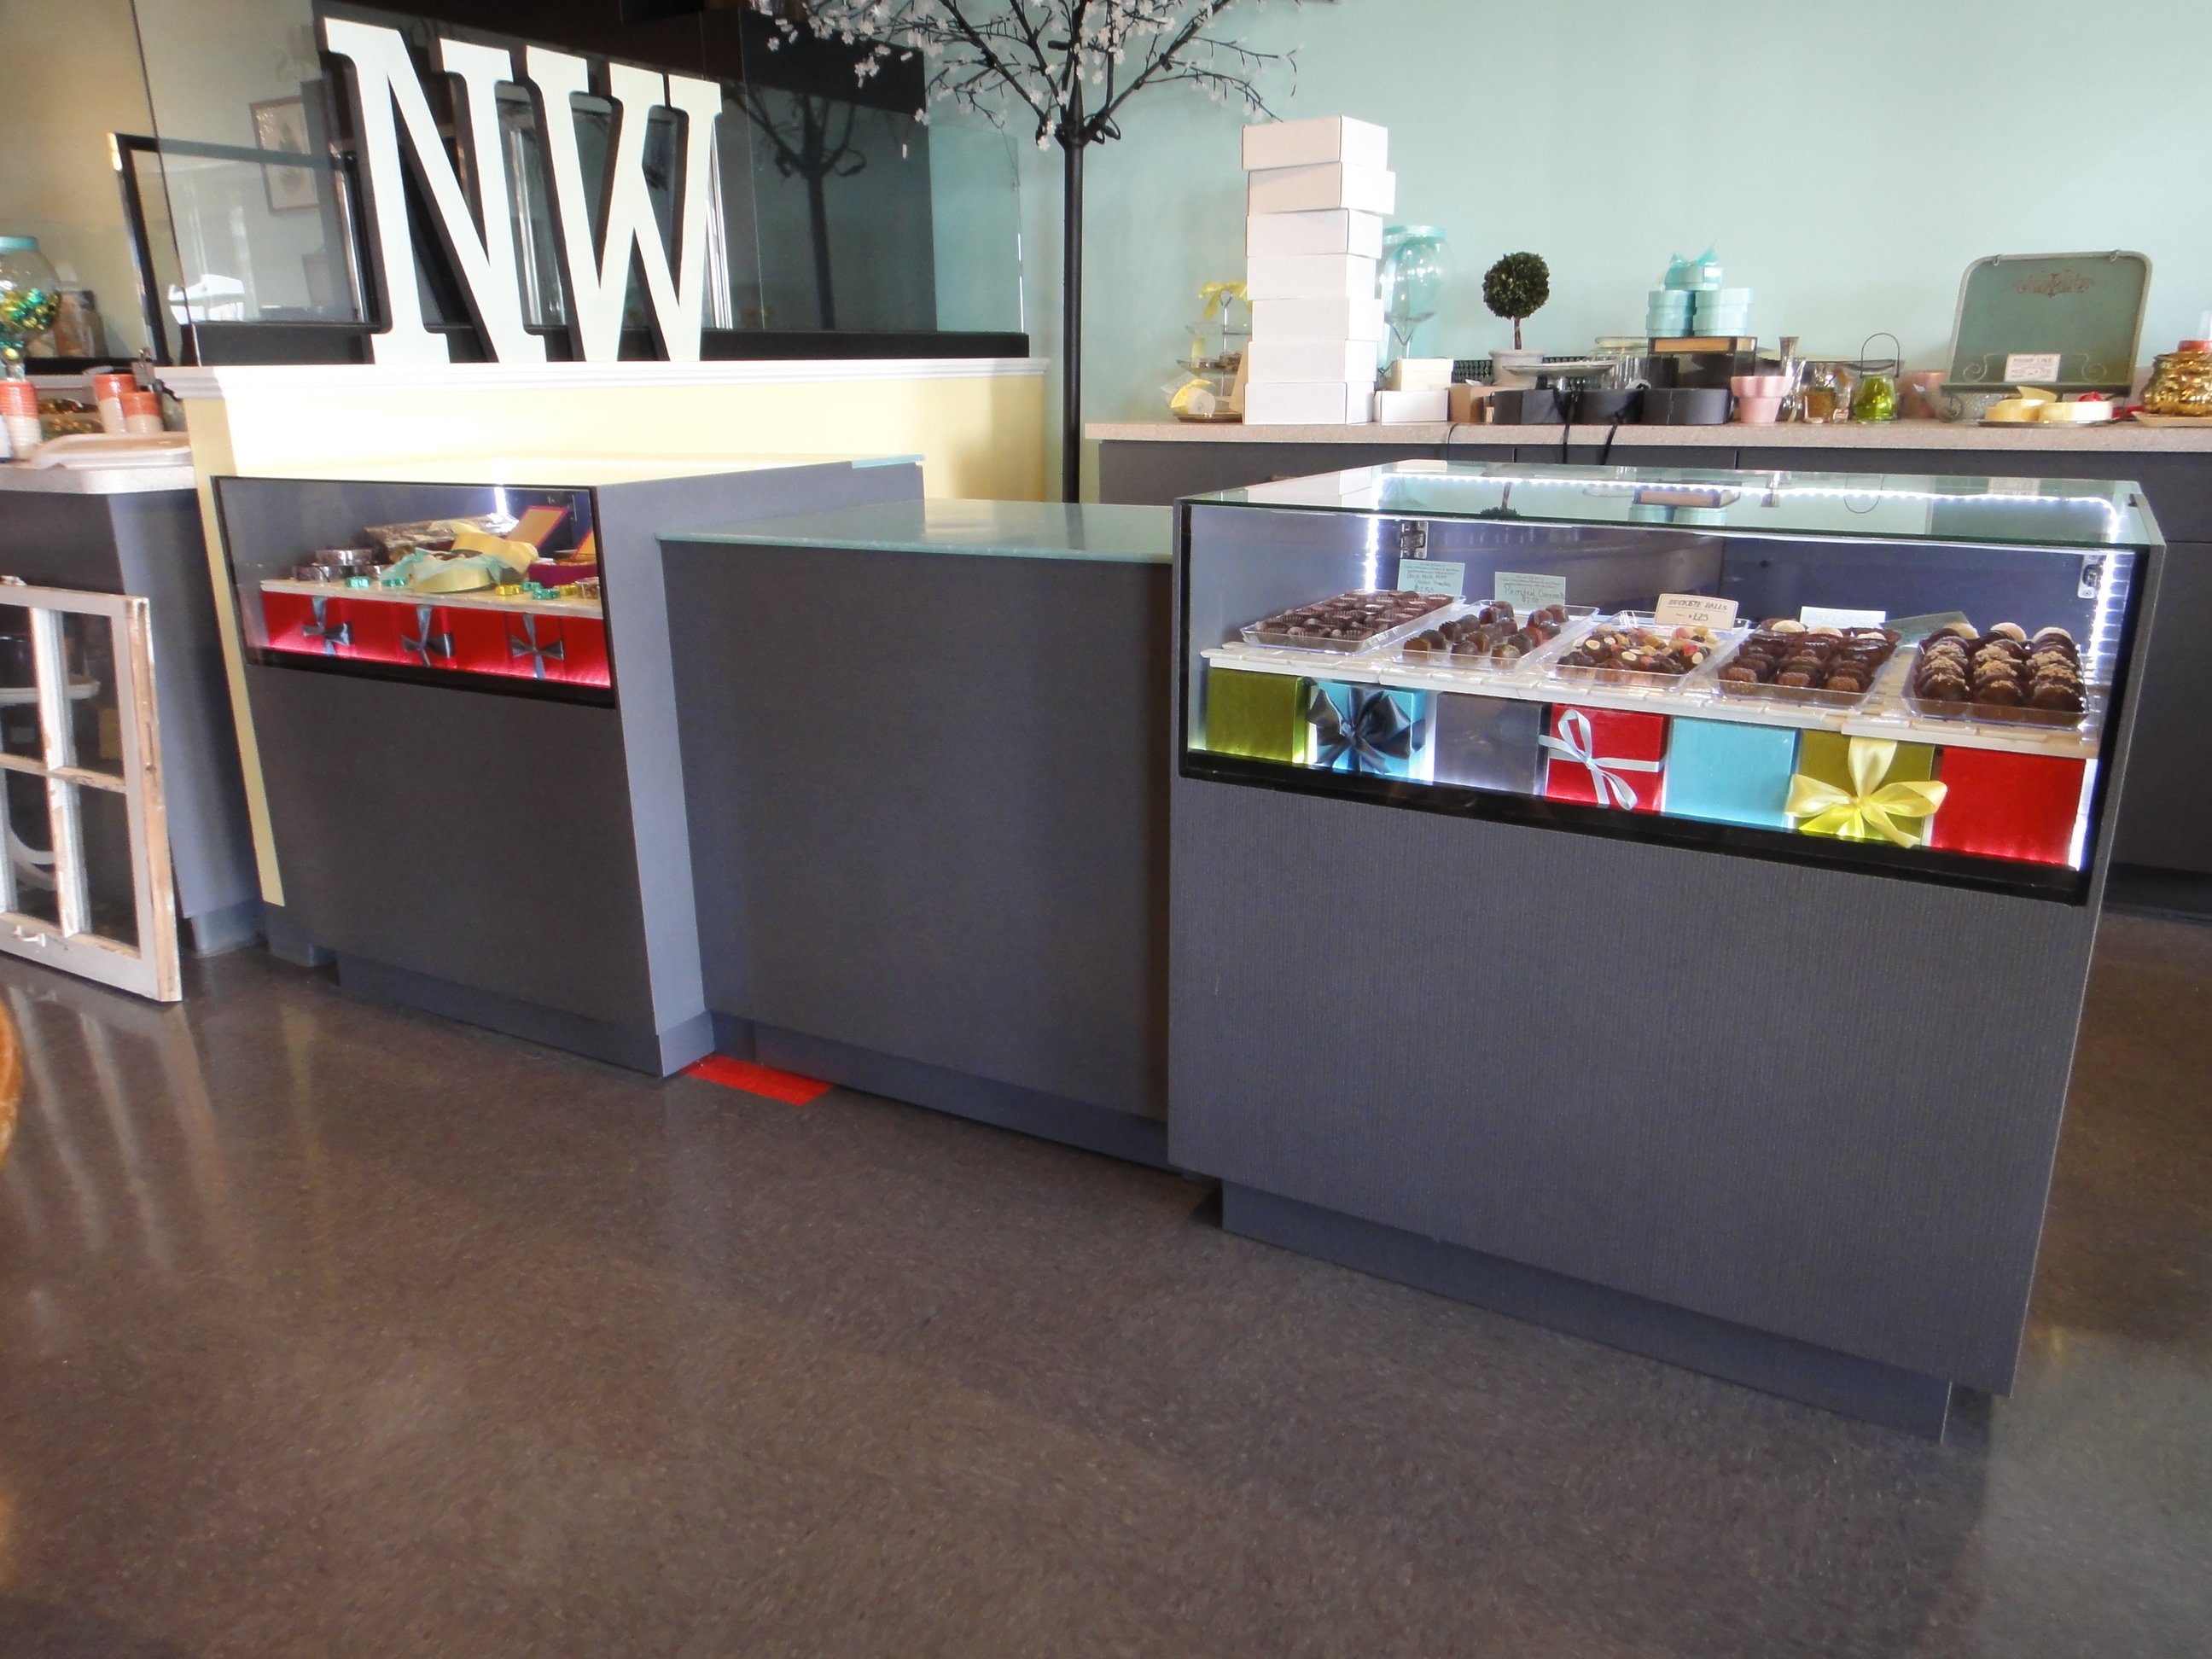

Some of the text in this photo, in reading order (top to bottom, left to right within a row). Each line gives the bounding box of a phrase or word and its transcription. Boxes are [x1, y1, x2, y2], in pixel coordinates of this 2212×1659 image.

[324, 17, 723, 364] NW
[1668, 599, 1728, 611] BUCKEYE BALLS
